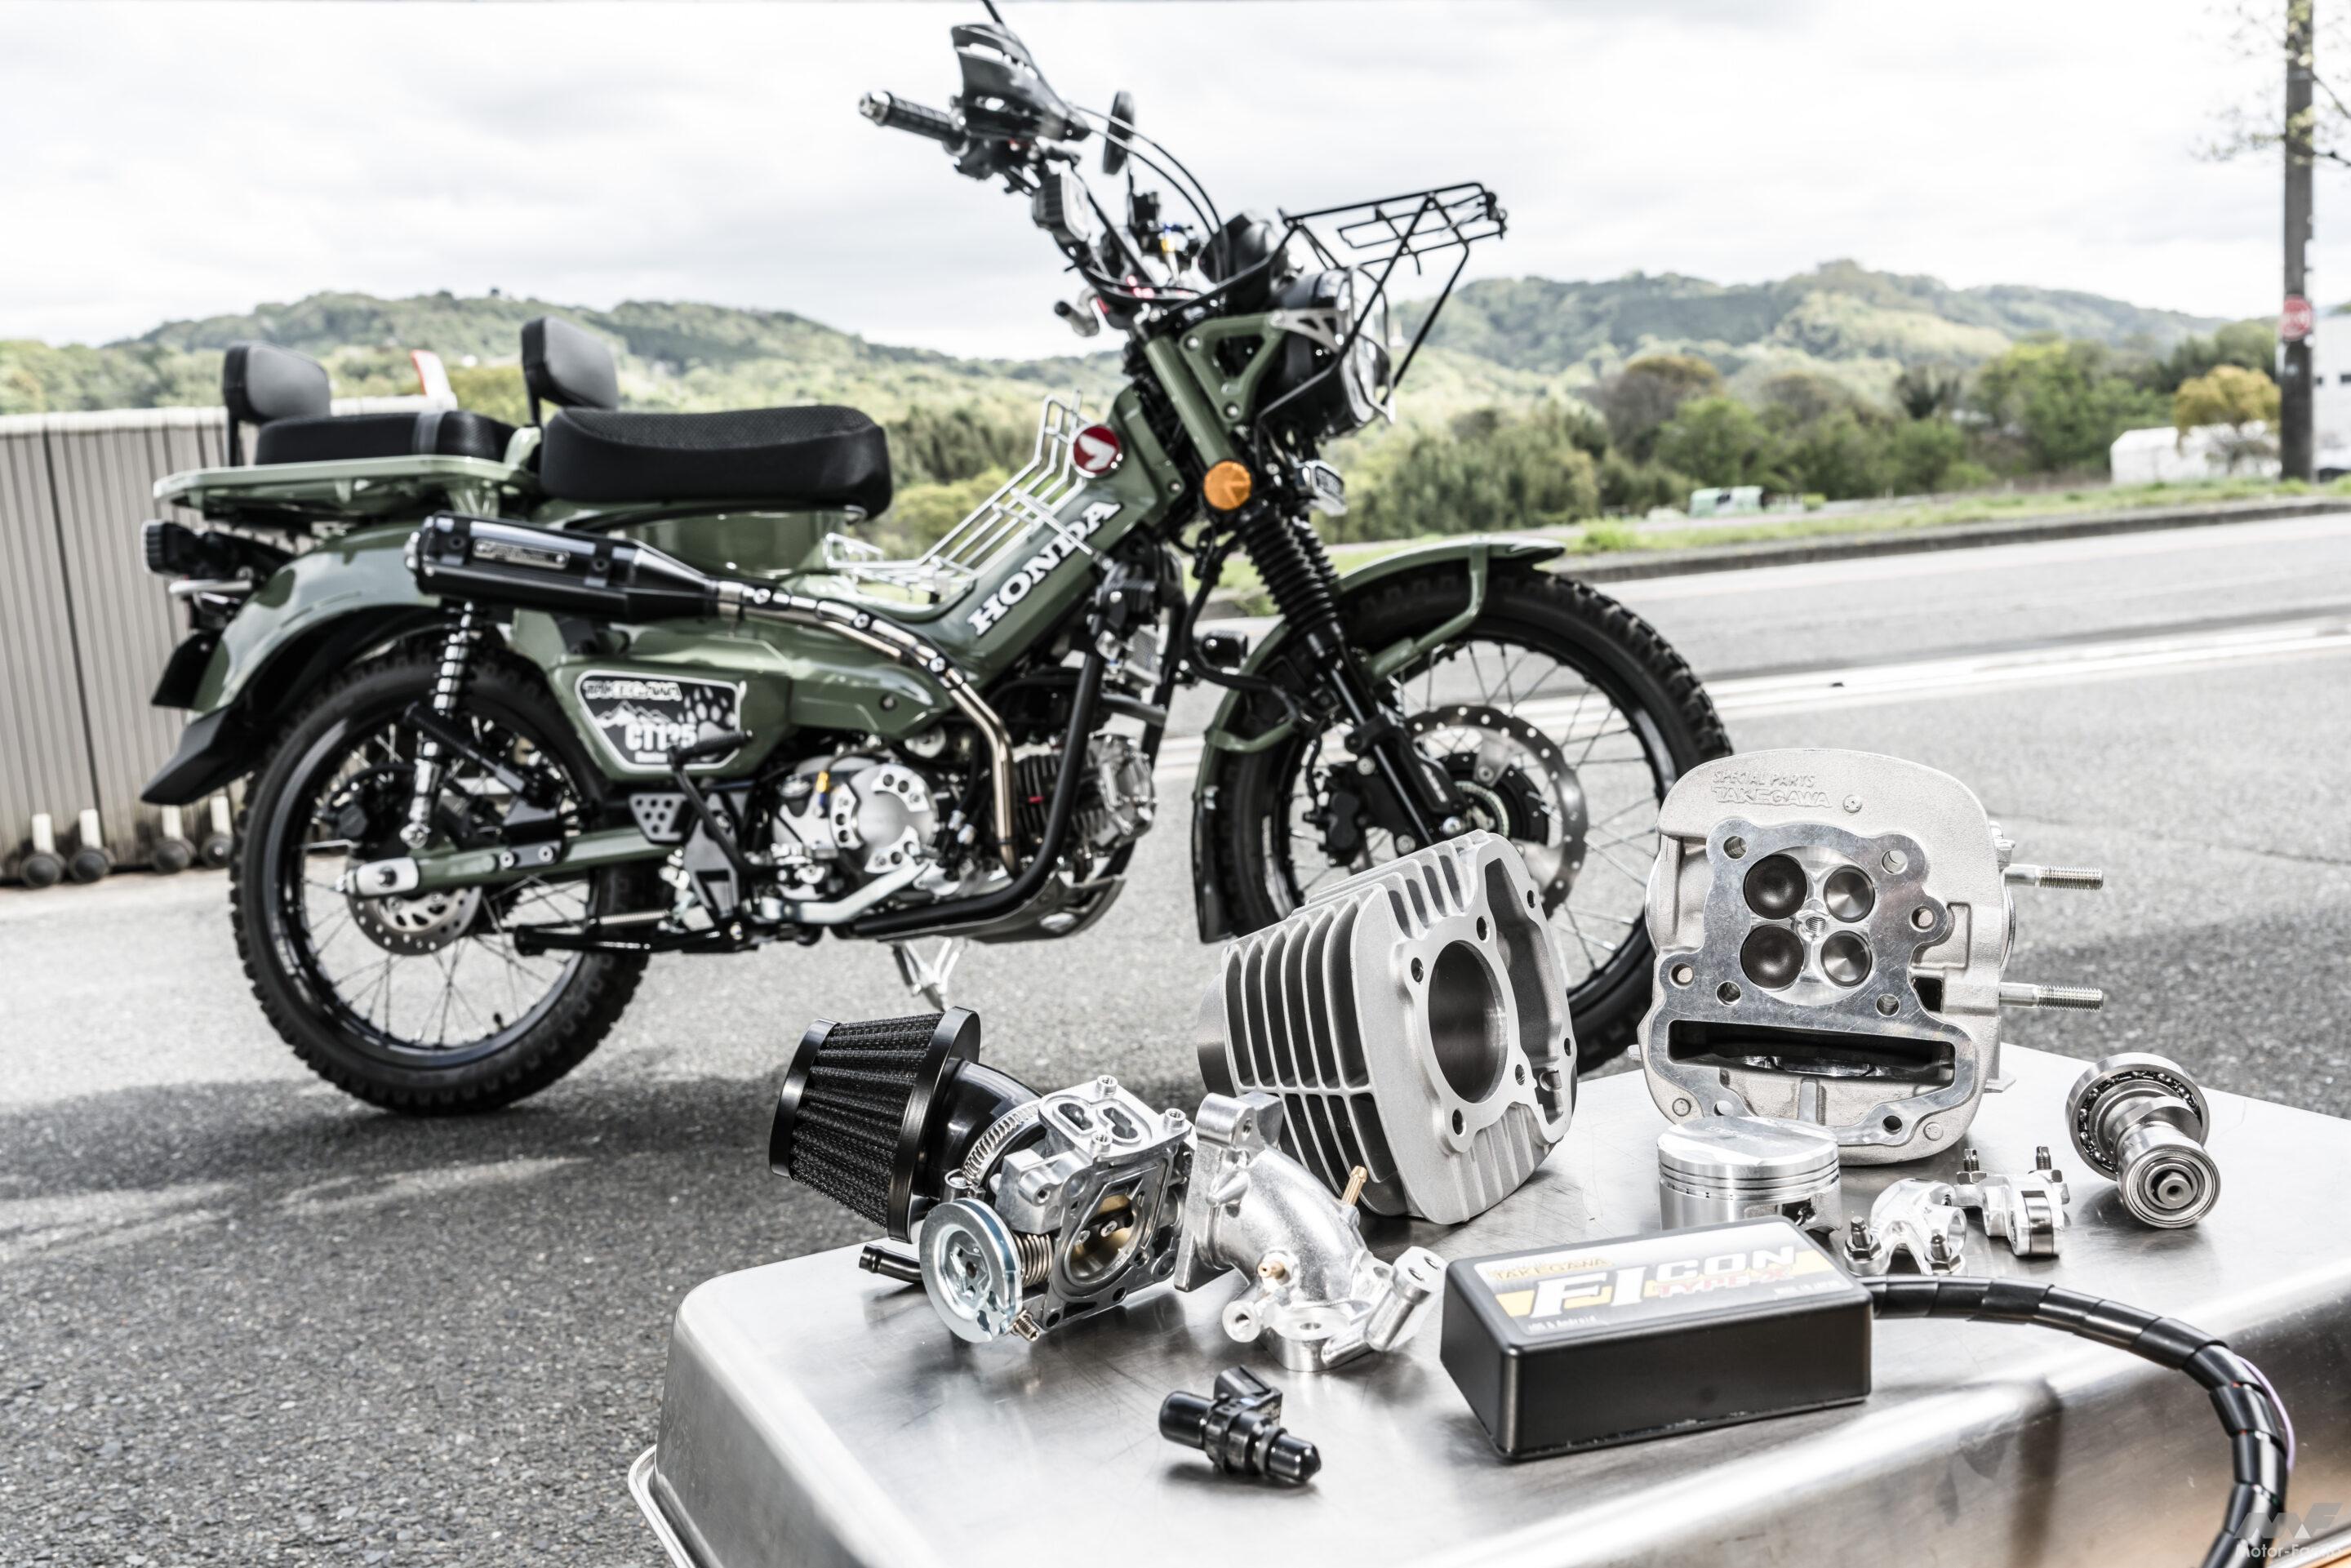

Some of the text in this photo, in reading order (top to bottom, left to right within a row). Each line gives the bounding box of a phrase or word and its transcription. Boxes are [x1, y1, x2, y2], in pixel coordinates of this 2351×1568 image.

[967, 501, 1122, 636] HONDA
[1711, 785, 1832, 806] TAKEGAWA
[1655, 1246, 1794, 1282] CON
